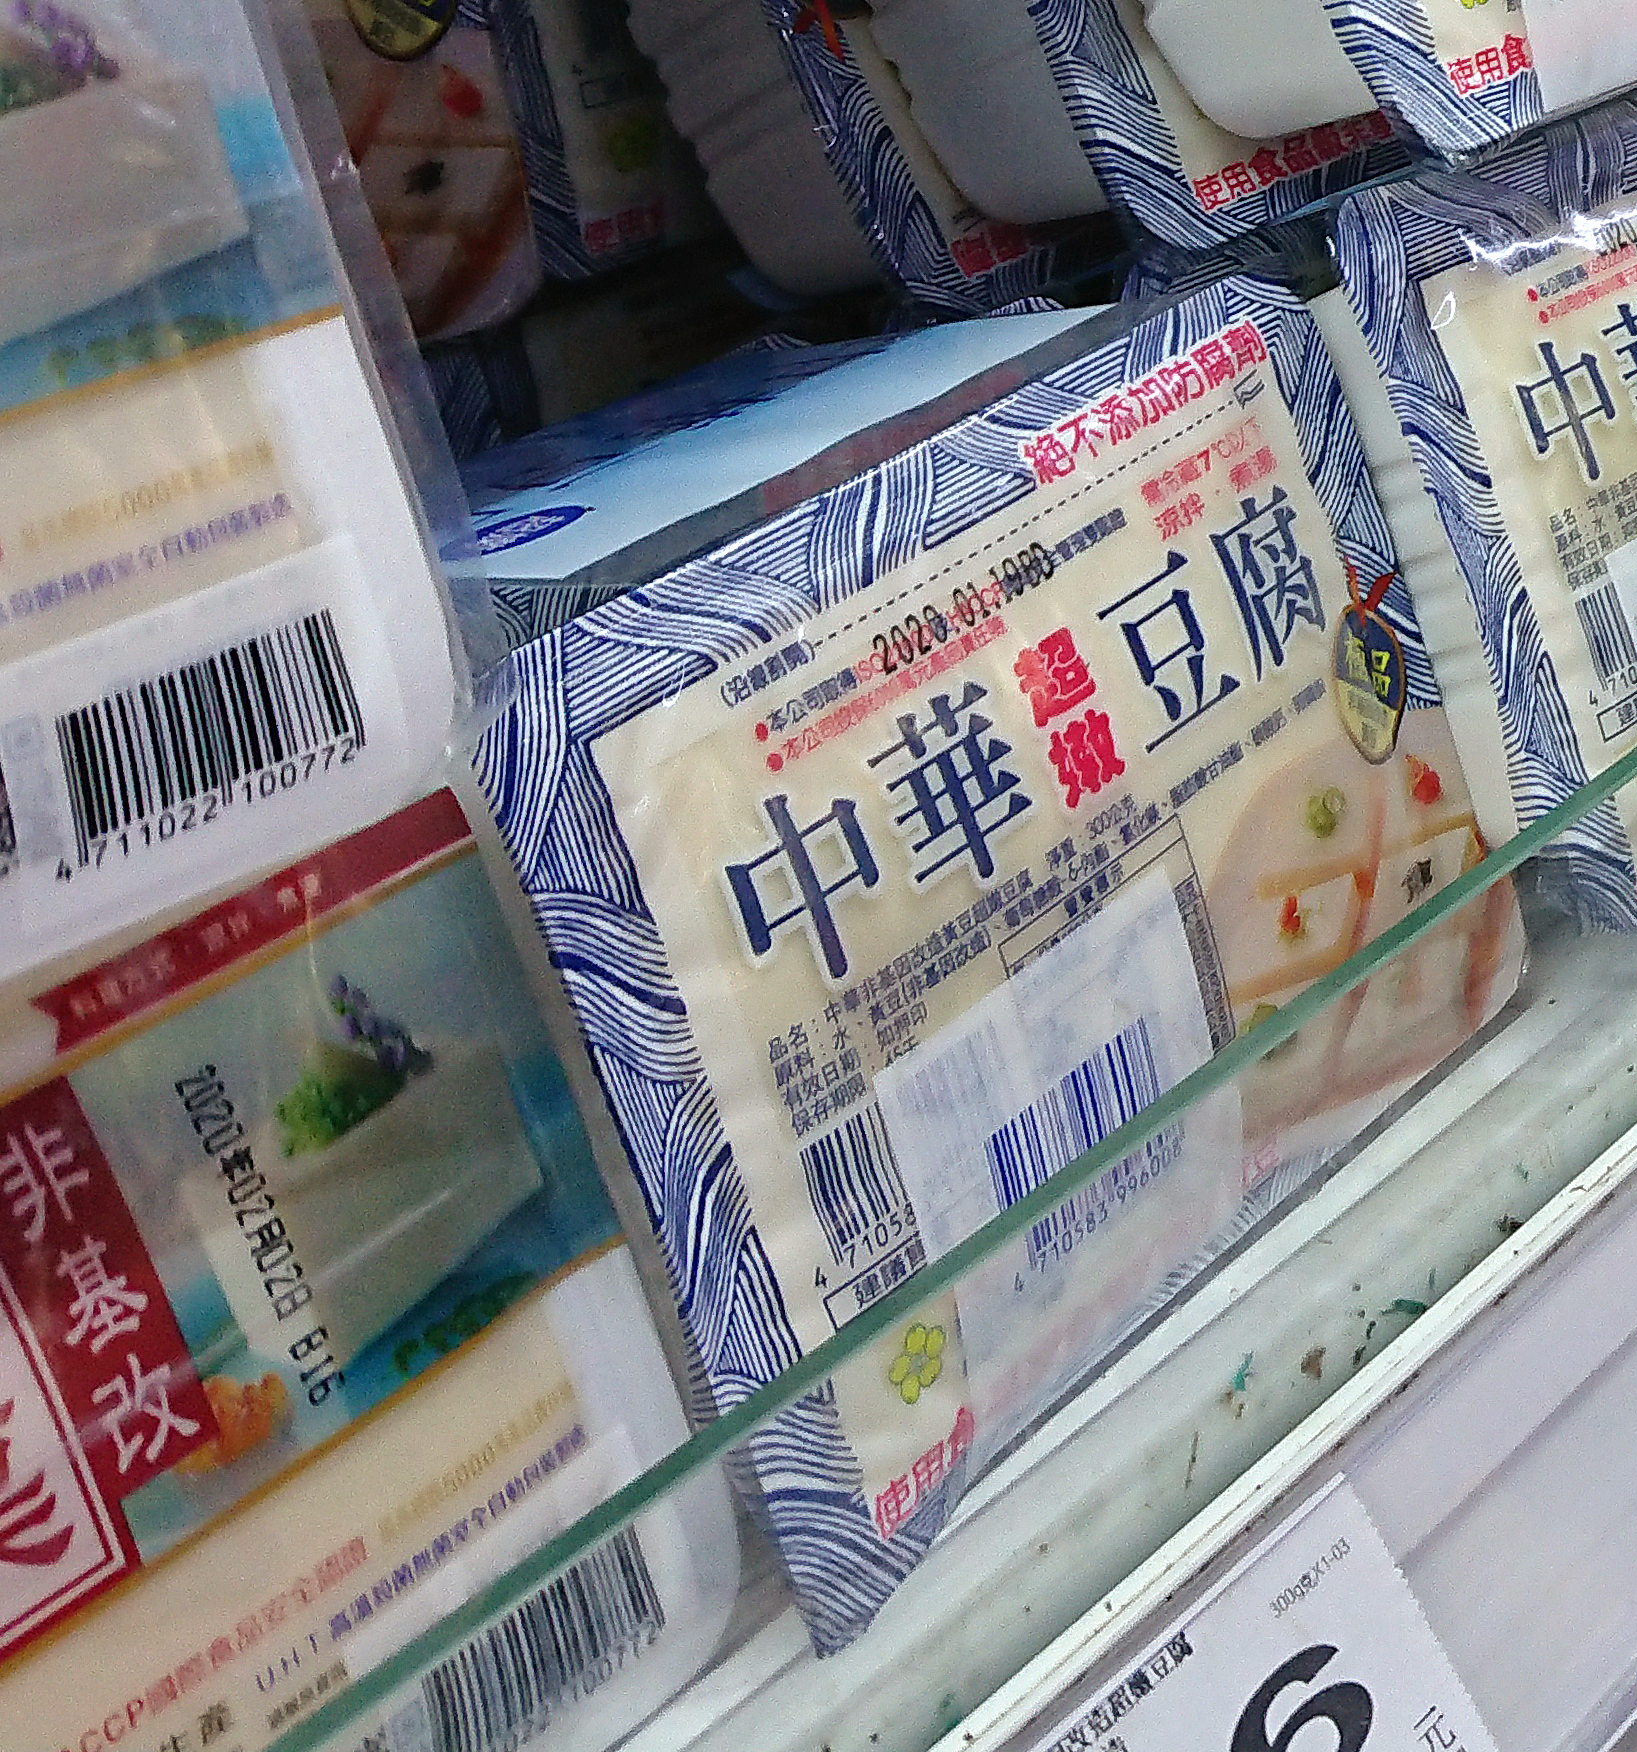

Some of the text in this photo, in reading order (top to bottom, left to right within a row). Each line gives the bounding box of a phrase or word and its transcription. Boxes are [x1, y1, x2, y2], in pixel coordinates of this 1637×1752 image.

[1021, 320, 1268, 485] 絕不添加防腐劑
[56, 737, 360, 881] 4 711022 100772
[726, 680, 1034, 978] 中華
[1014, 627, 1124, 808] 超嫩
[1097, 484, 1325, 755] 豆腐
[2, 1120, 201, 1476] 非基改
